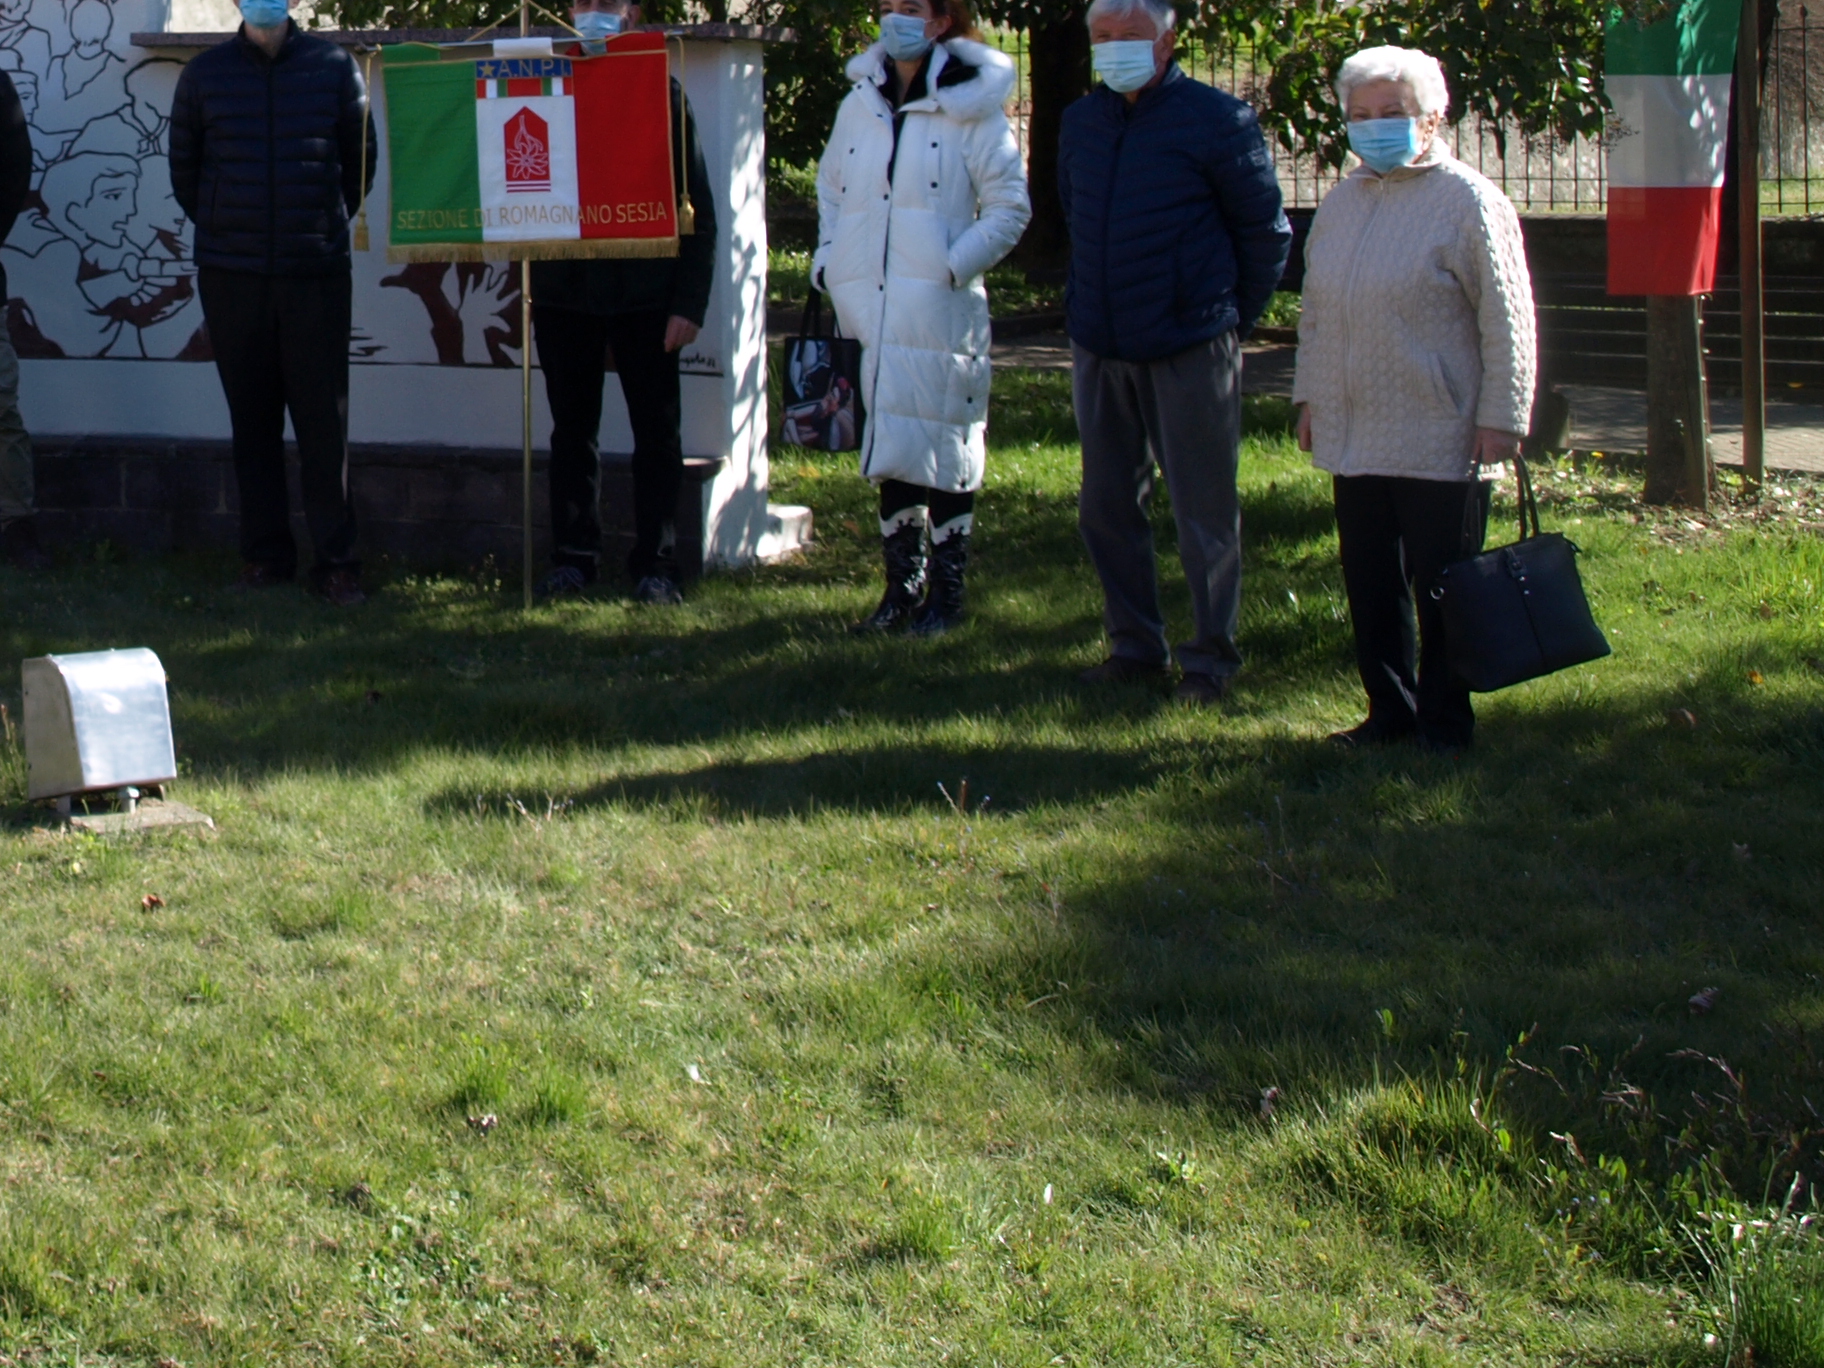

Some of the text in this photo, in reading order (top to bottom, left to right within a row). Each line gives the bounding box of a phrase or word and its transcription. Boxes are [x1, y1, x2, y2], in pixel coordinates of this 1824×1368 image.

[397, 201, 668, 229] SEZIONE DI ROMAGNANO SESIA
